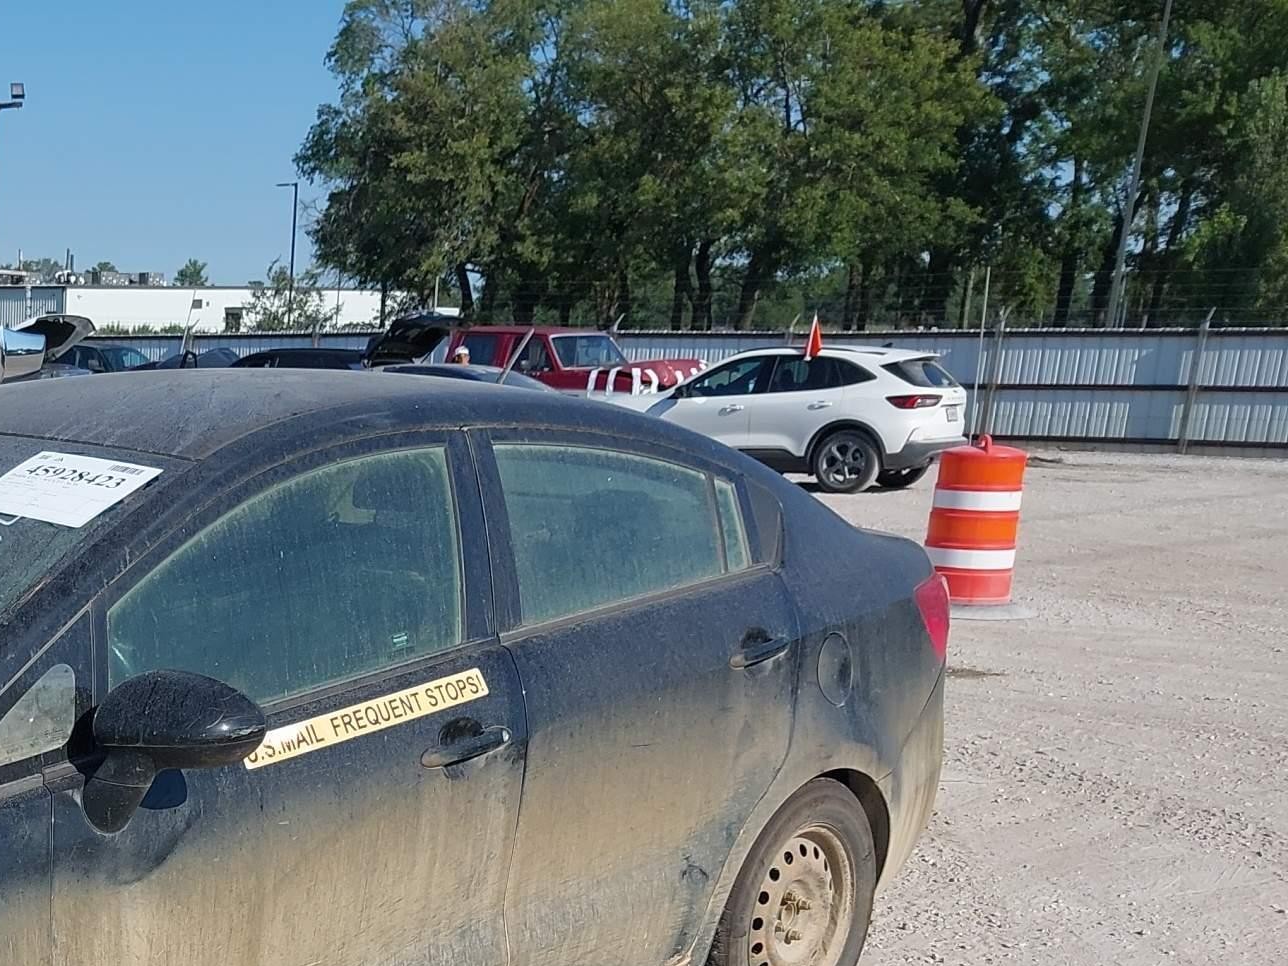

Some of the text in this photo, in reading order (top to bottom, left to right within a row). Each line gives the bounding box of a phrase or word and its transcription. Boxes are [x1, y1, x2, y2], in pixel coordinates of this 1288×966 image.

[25, 464, 127, 489] 45928423
[329, 692, 422, 737] FREQUENT
[424, 673, 485, 708] STOPS!
